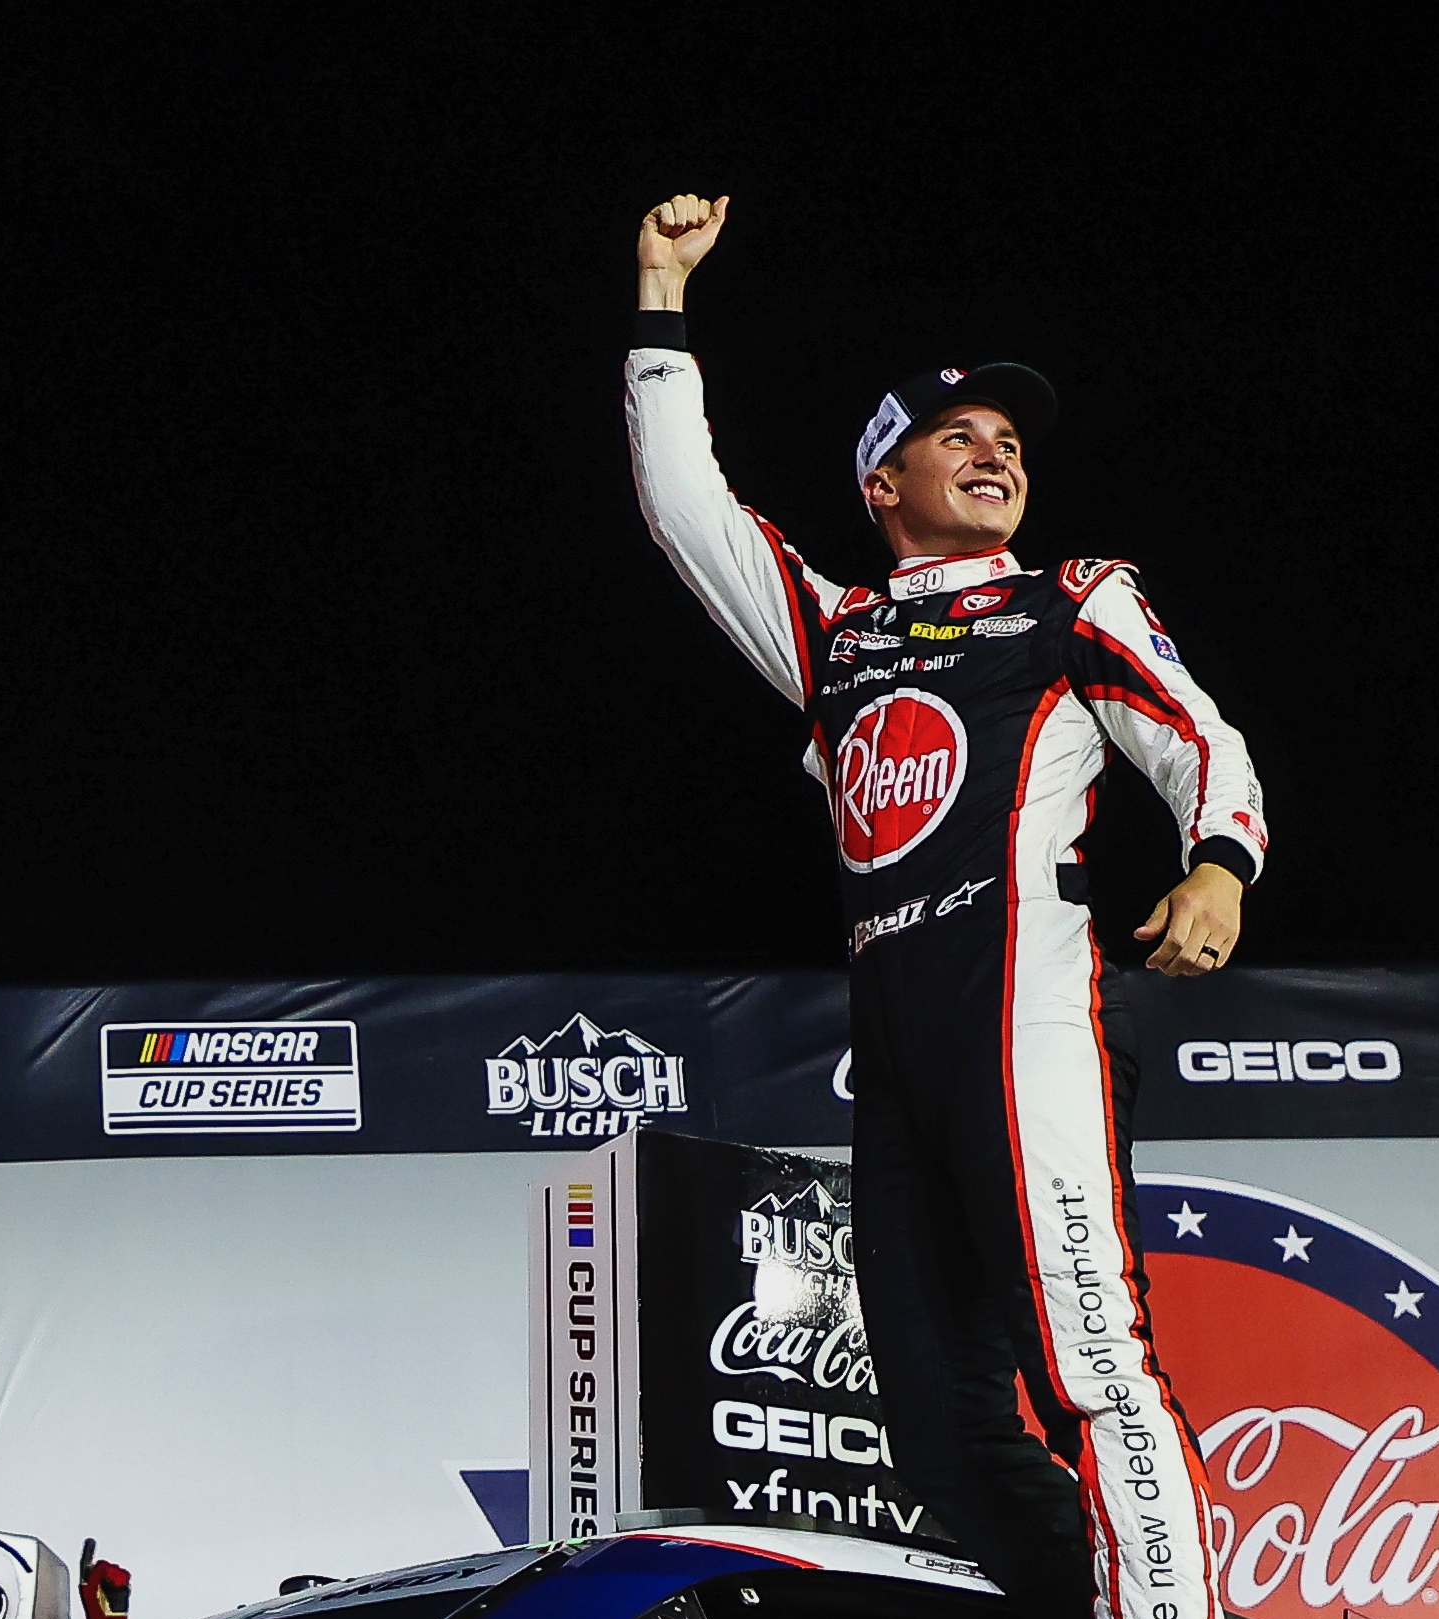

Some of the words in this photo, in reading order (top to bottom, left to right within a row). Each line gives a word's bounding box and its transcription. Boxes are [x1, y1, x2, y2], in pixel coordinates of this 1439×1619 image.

[907, 567, 944, 597] 20
[842, 706, 950, 842] Rheem
[183, 1031, 319, 1063] NASCAR
[1176, 1041, 1400, 1081] GEICO
[139, 1079, 205, 1108] CUP
[209, 1078, 324, 1107] SERIES
[485, 1055, 688, 1114] BUSCH
[531, 1111, 645, 1136] LIGHT
[741, 1210, 855, 1276] BUSC
[568, 1261, 597, 1360] CUP
[710, 1301, 879, 1395] Coca-Co
[1079, 1347, 1116, 1375] of
[568, 1370, 598, 1539] SERIES
[712, 1400, 893, 1469] GEIC
[1105, 1383, 1159, 1500] degree
[1143, 1514, 1173, 1586] new
